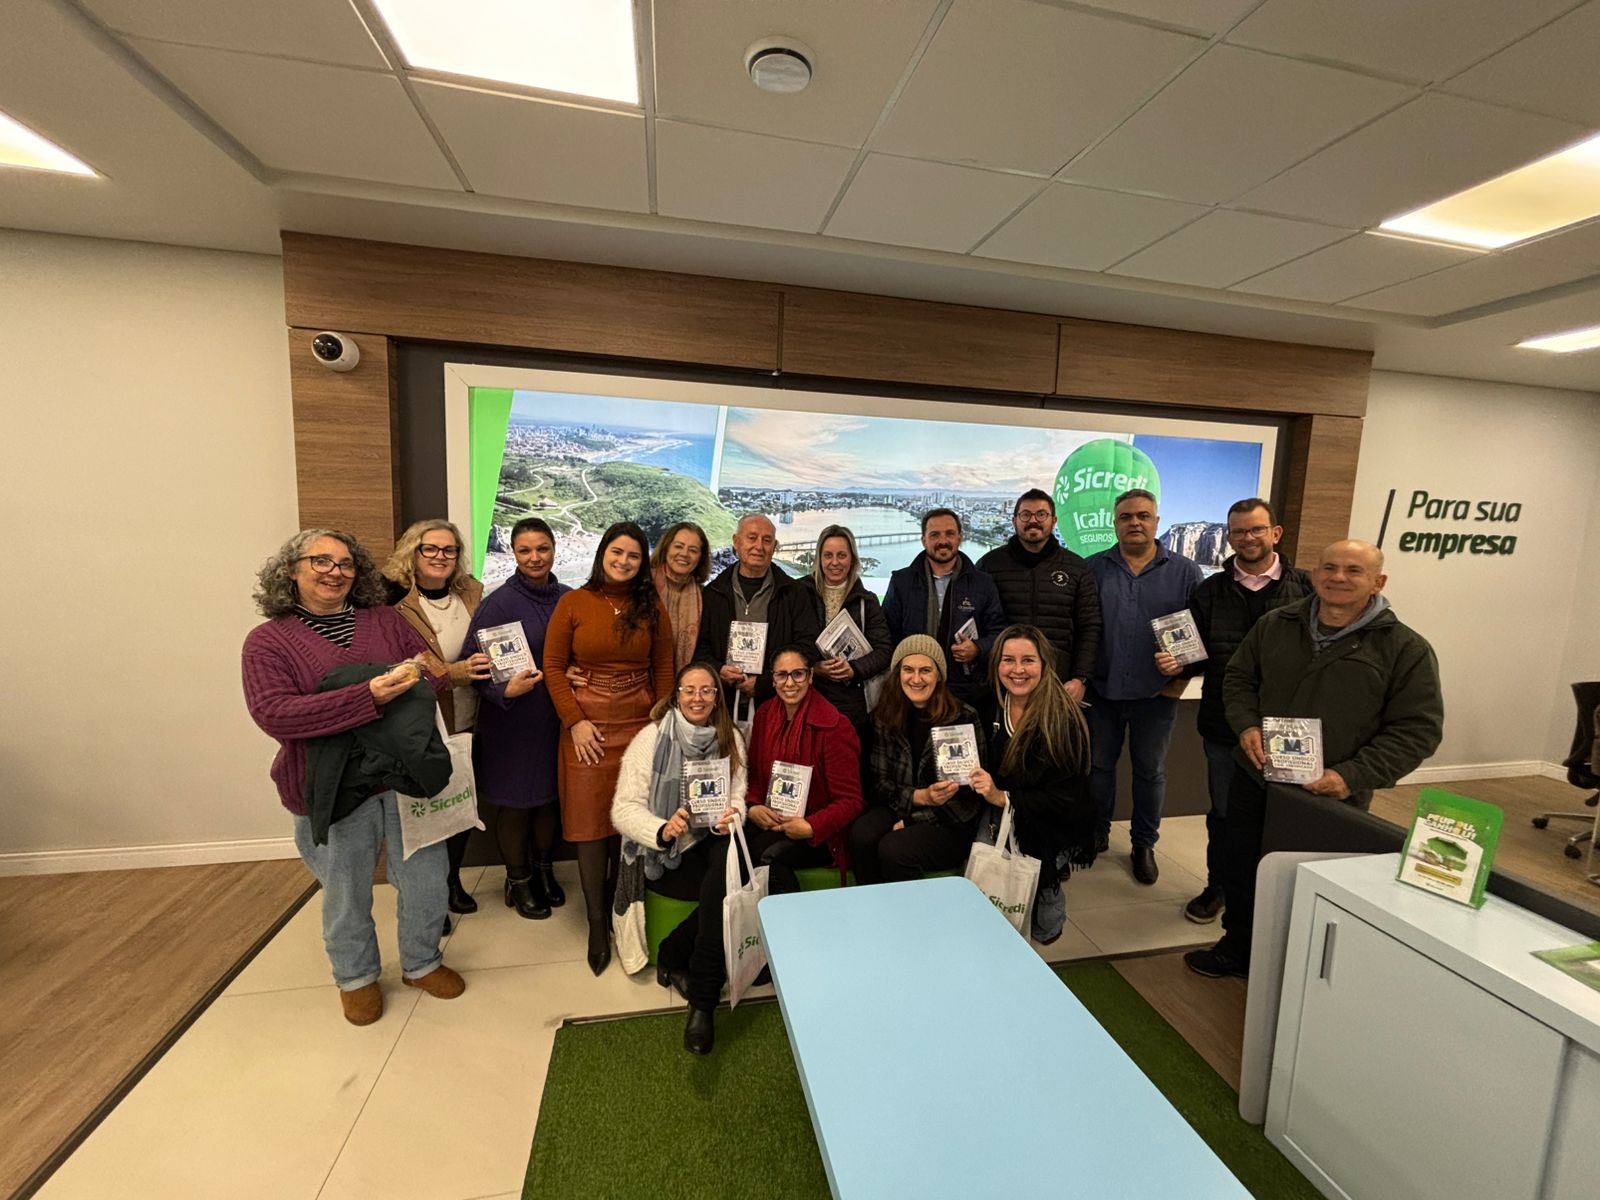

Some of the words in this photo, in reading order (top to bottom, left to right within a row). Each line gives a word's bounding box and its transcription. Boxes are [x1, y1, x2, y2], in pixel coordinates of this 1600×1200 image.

[1073, 467, 1148, 493] Sicredi
[1407, 490, 1471, 521] Para
[1474, 501, 1522, 522] sua
[1080, 533, 1113, 545] SEGUROS
[1399, 531, 1518, 560] empresa
[430, 785, 473, 813] Sicredi
[989, 896, 1025, 914] Sicredi
